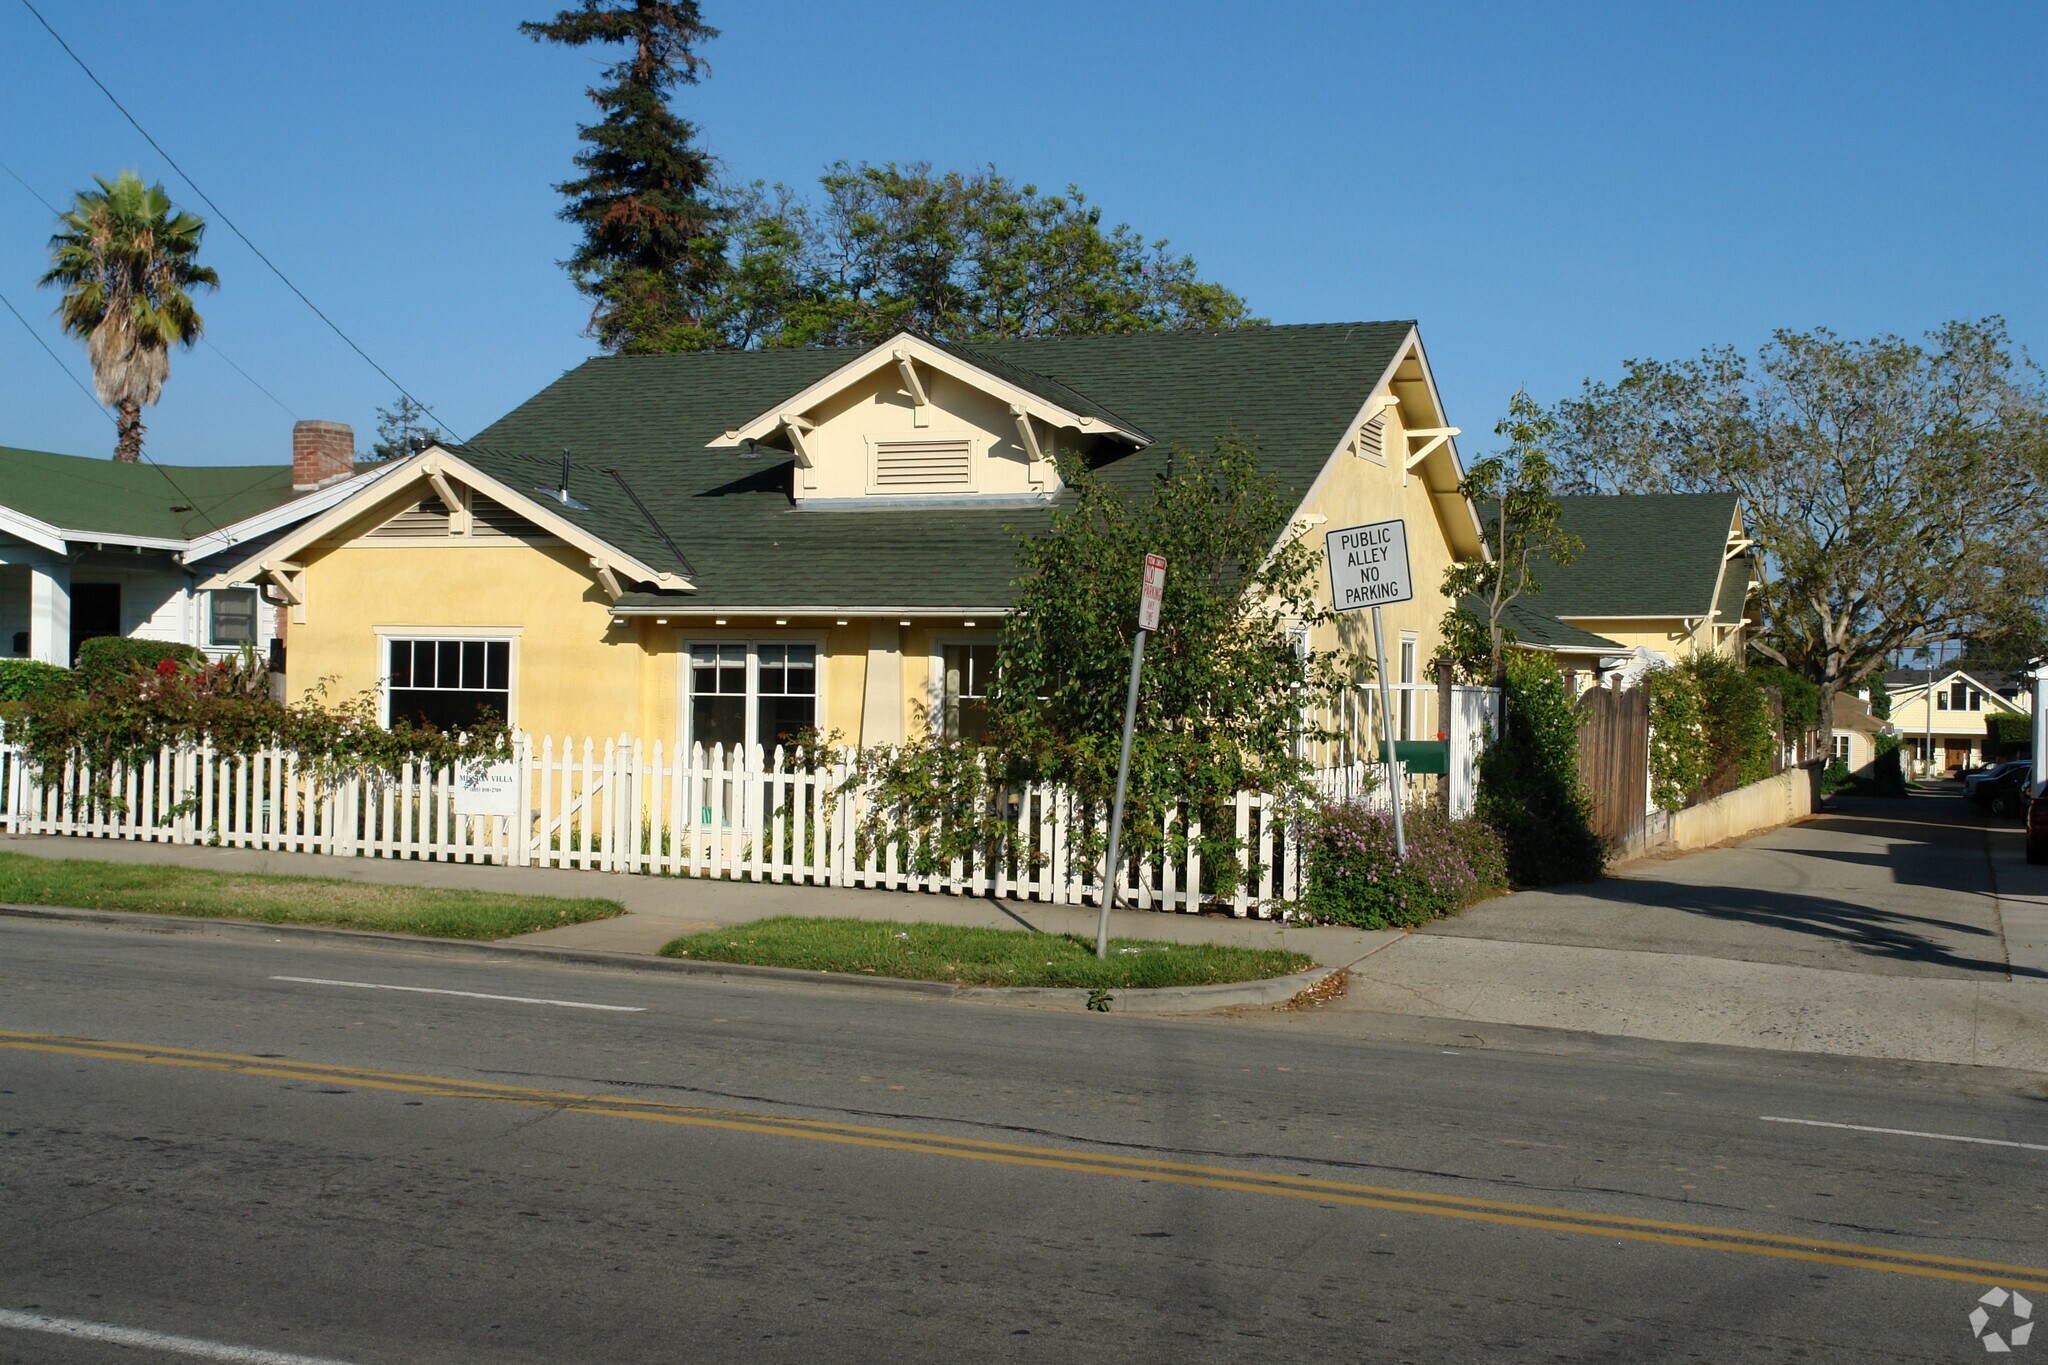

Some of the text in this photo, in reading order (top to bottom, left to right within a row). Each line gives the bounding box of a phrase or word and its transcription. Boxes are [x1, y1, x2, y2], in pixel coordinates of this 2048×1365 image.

[1341, 528, 1391, 550] PUBLIC
[1347, 546, 1388, 567] ALLEY
[1144, 566, 1155, 584] NO
[1360, 567, 1380, 583] NO
[1143, 584, 1162, 601] PARKING
[1346, 581, 1399, 604] PARKING
[491, 775, 513, 783] VILLA
